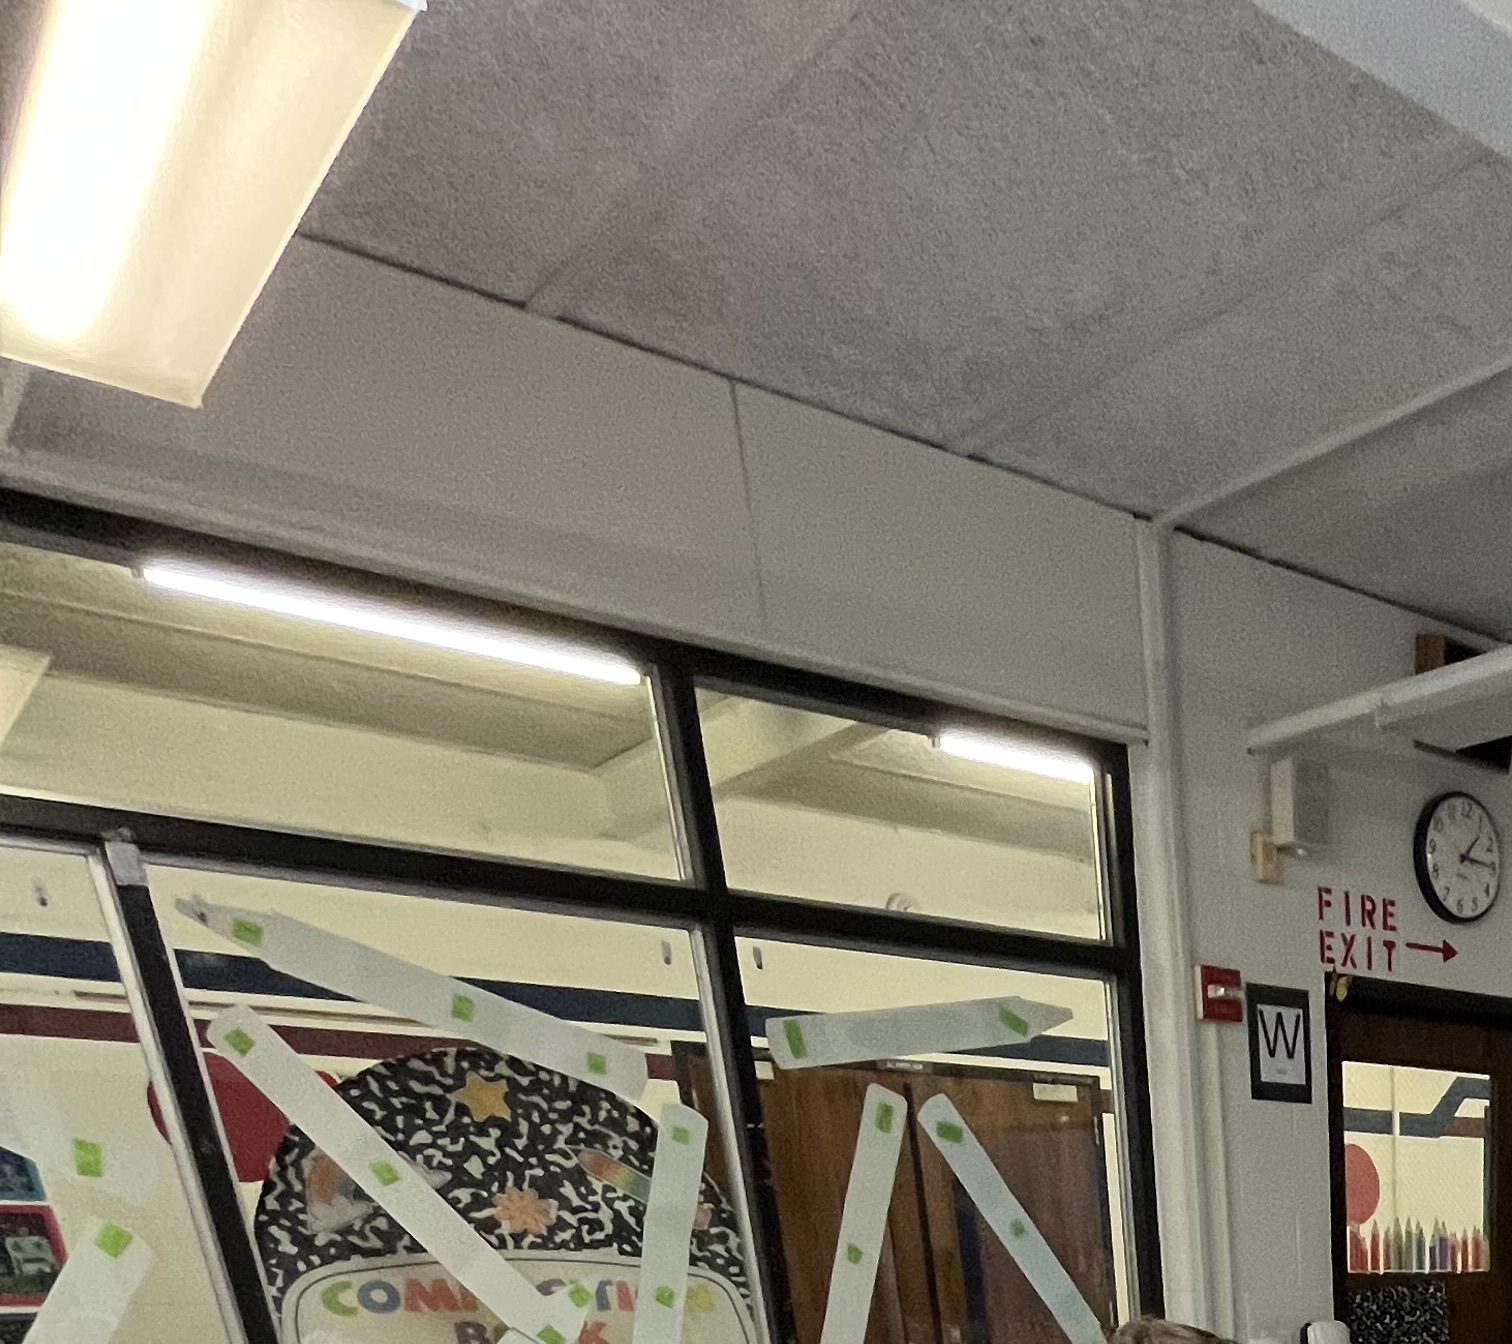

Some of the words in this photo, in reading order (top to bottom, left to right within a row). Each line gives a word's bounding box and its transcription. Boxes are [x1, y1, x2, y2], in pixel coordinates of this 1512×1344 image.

[1461, 800, 1472, 819] 12
[1429, 838, 1436, 854] 9
[1486, 836, 1494, 853] 2
[1432, 863, 1439, 880] 8
[1443, 886, 1450, 901] 7
[1317, 886, 1397, 932] FIRE
[1457, 898, 1464, 914] 6
[1471, 896, 1478, 912] 5
[1319, 929, 1397, 972] EXIT
[1259, 1009, 1301, 1059] W
